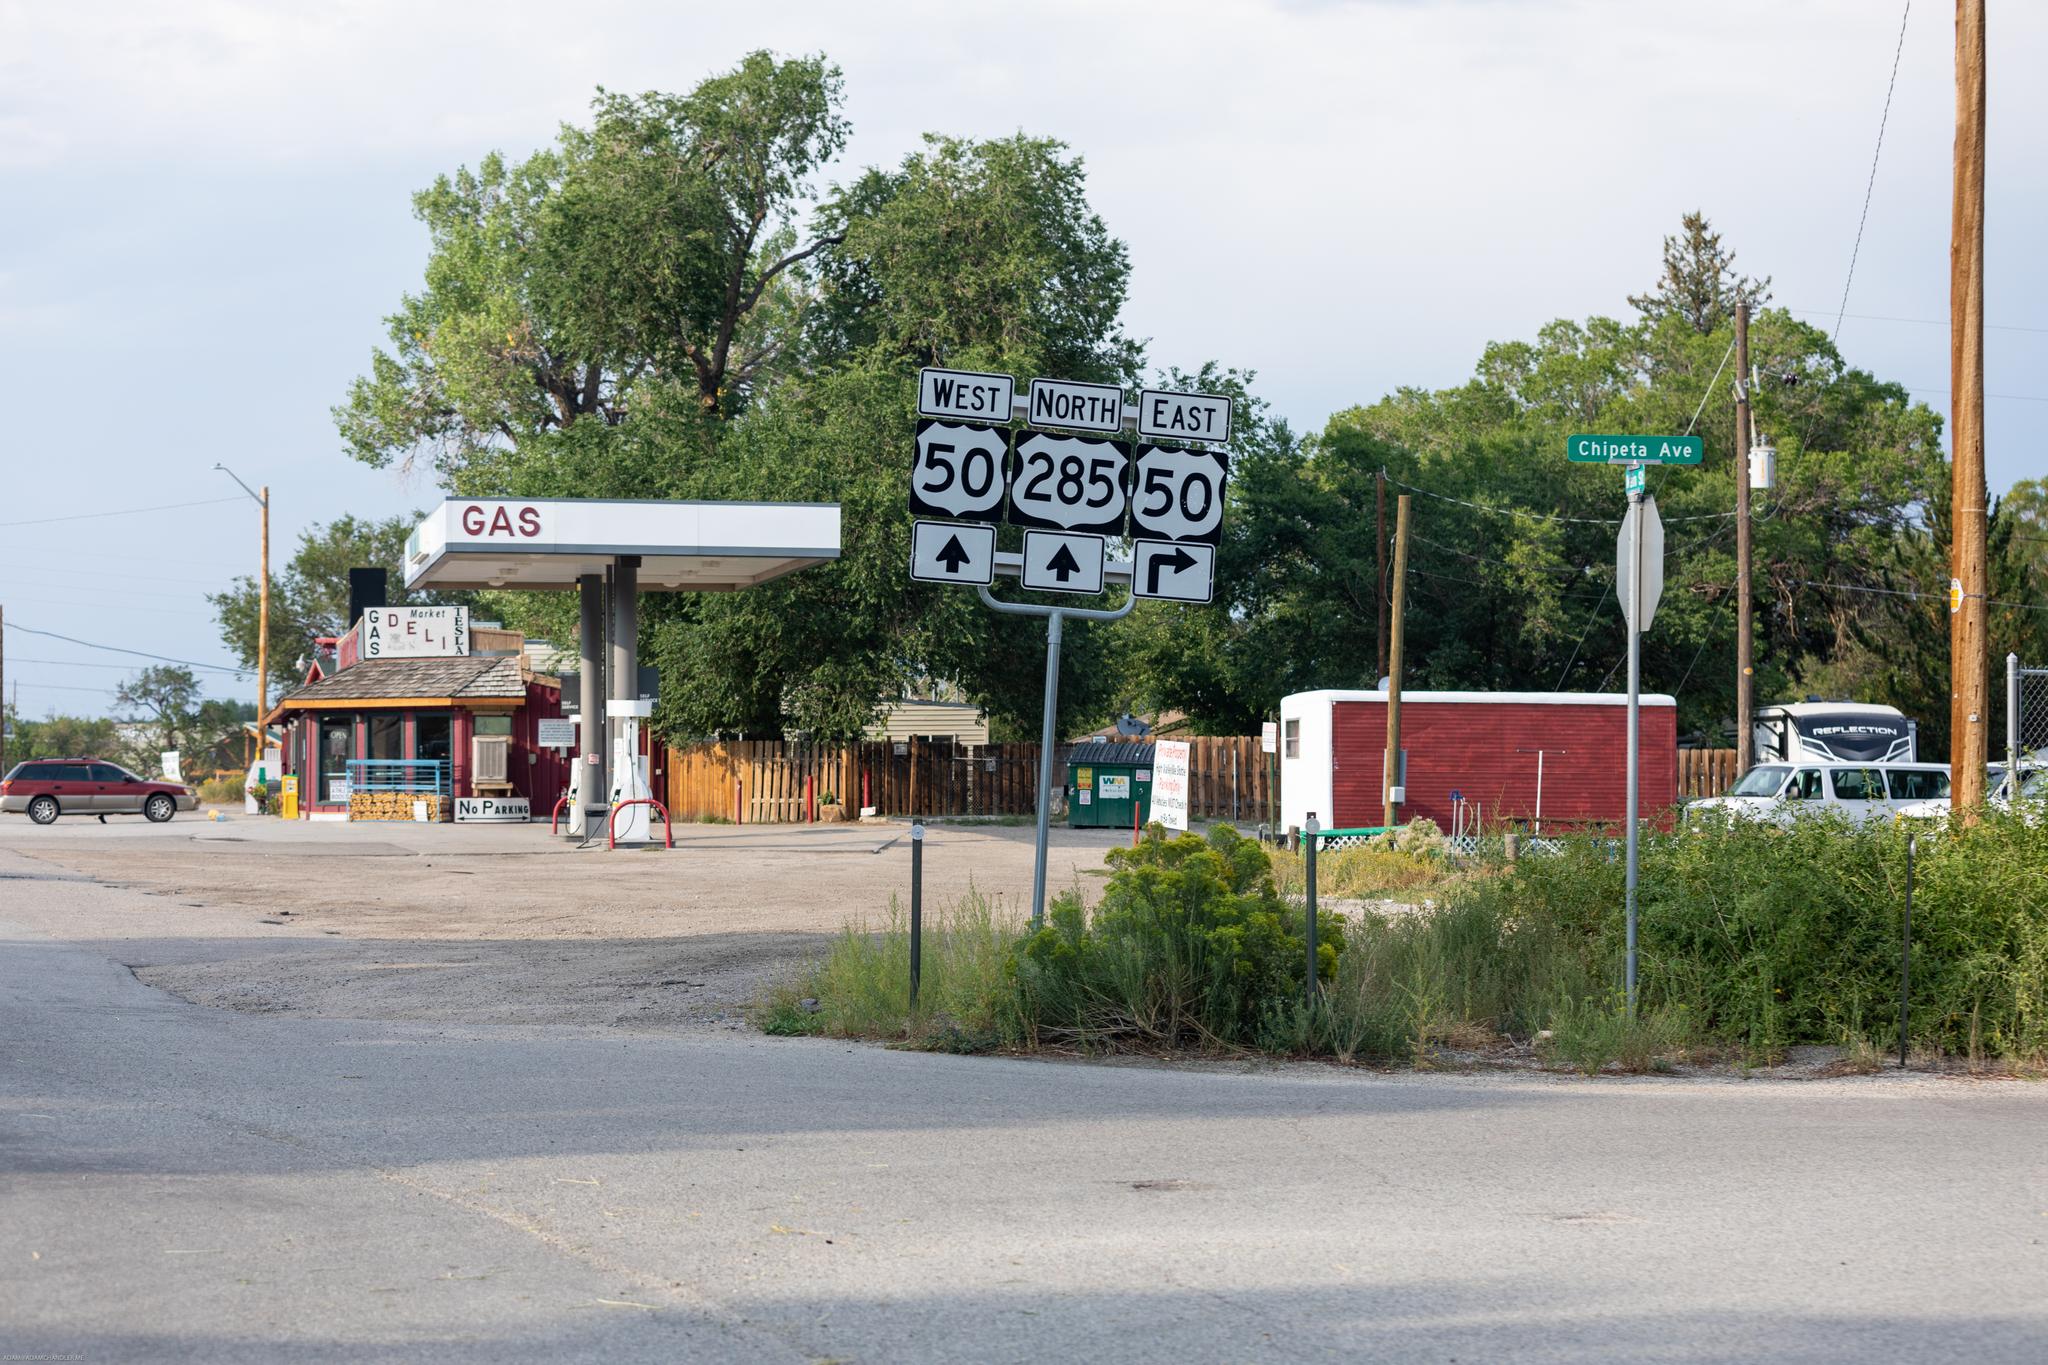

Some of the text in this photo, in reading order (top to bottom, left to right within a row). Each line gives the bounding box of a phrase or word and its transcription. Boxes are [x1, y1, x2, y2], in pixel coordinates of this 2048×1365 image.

[933, 377, 1000, 412] WEST
[1036, 388, 1115, 424] NORTH
[1153, 398, 1217, 433] EAST
[1579, 440, 1692, 459] Chipeta Ave
[921, 442, 995, 498] 50
[1023, 451, 1115, 508] 285
[1141, 467, 1213, 522] 50
[463, 505, 541, 537] GAS
[410, 609, 446, 618] Market
[454, 607, 464, 655] TESLA
[369, 610, 380, 655] GAS
[388, 614, 446, 650] DELI
[1812, 726, 1898, 736] REFLECTION
